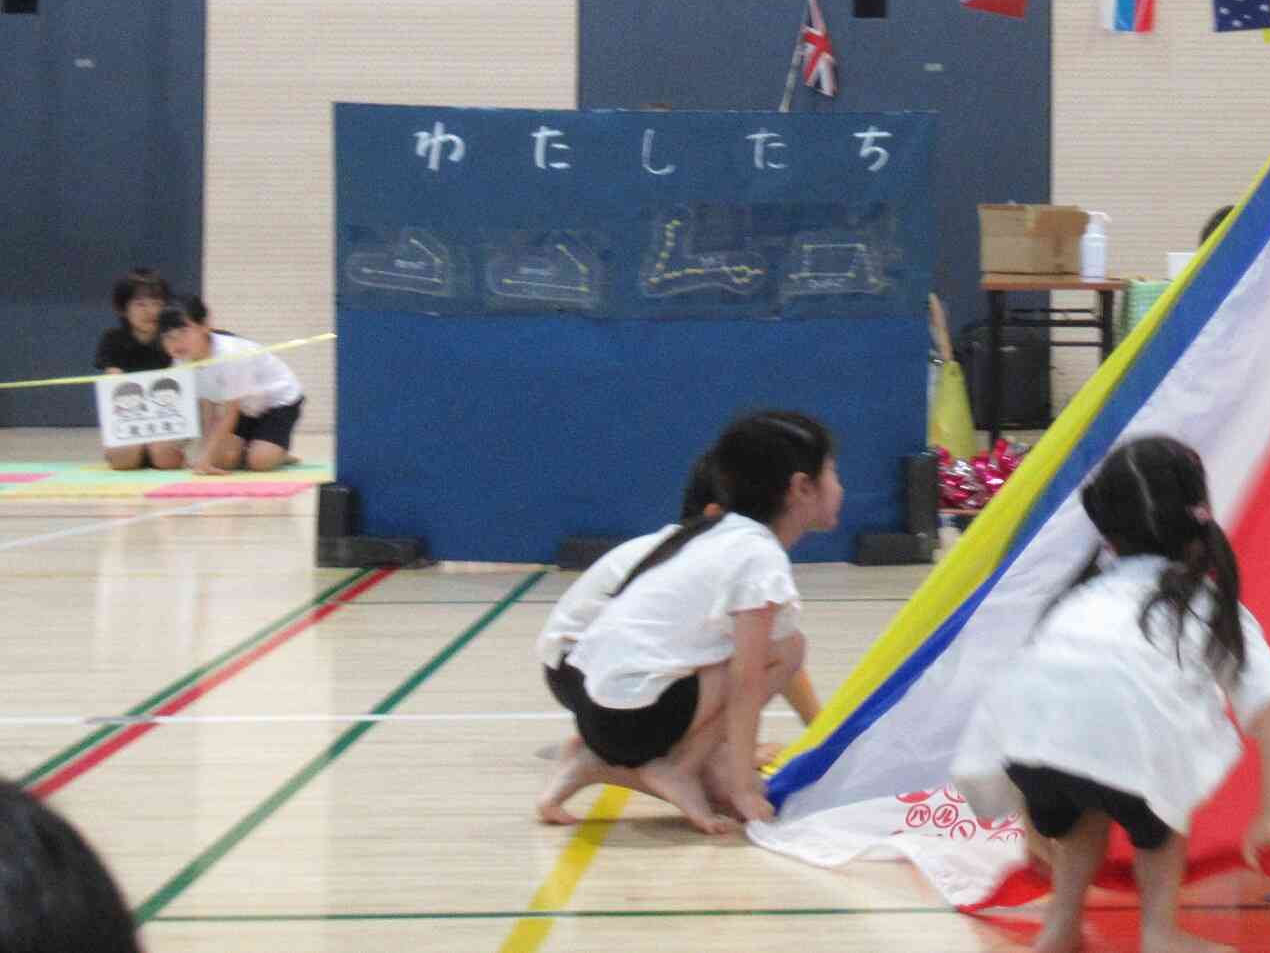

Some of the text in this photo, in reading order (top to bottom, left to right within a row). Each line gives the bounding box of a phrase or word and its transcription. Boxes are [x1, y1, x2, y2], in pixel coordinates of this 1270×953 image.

[412, 120, 893, 174] わたしたち
